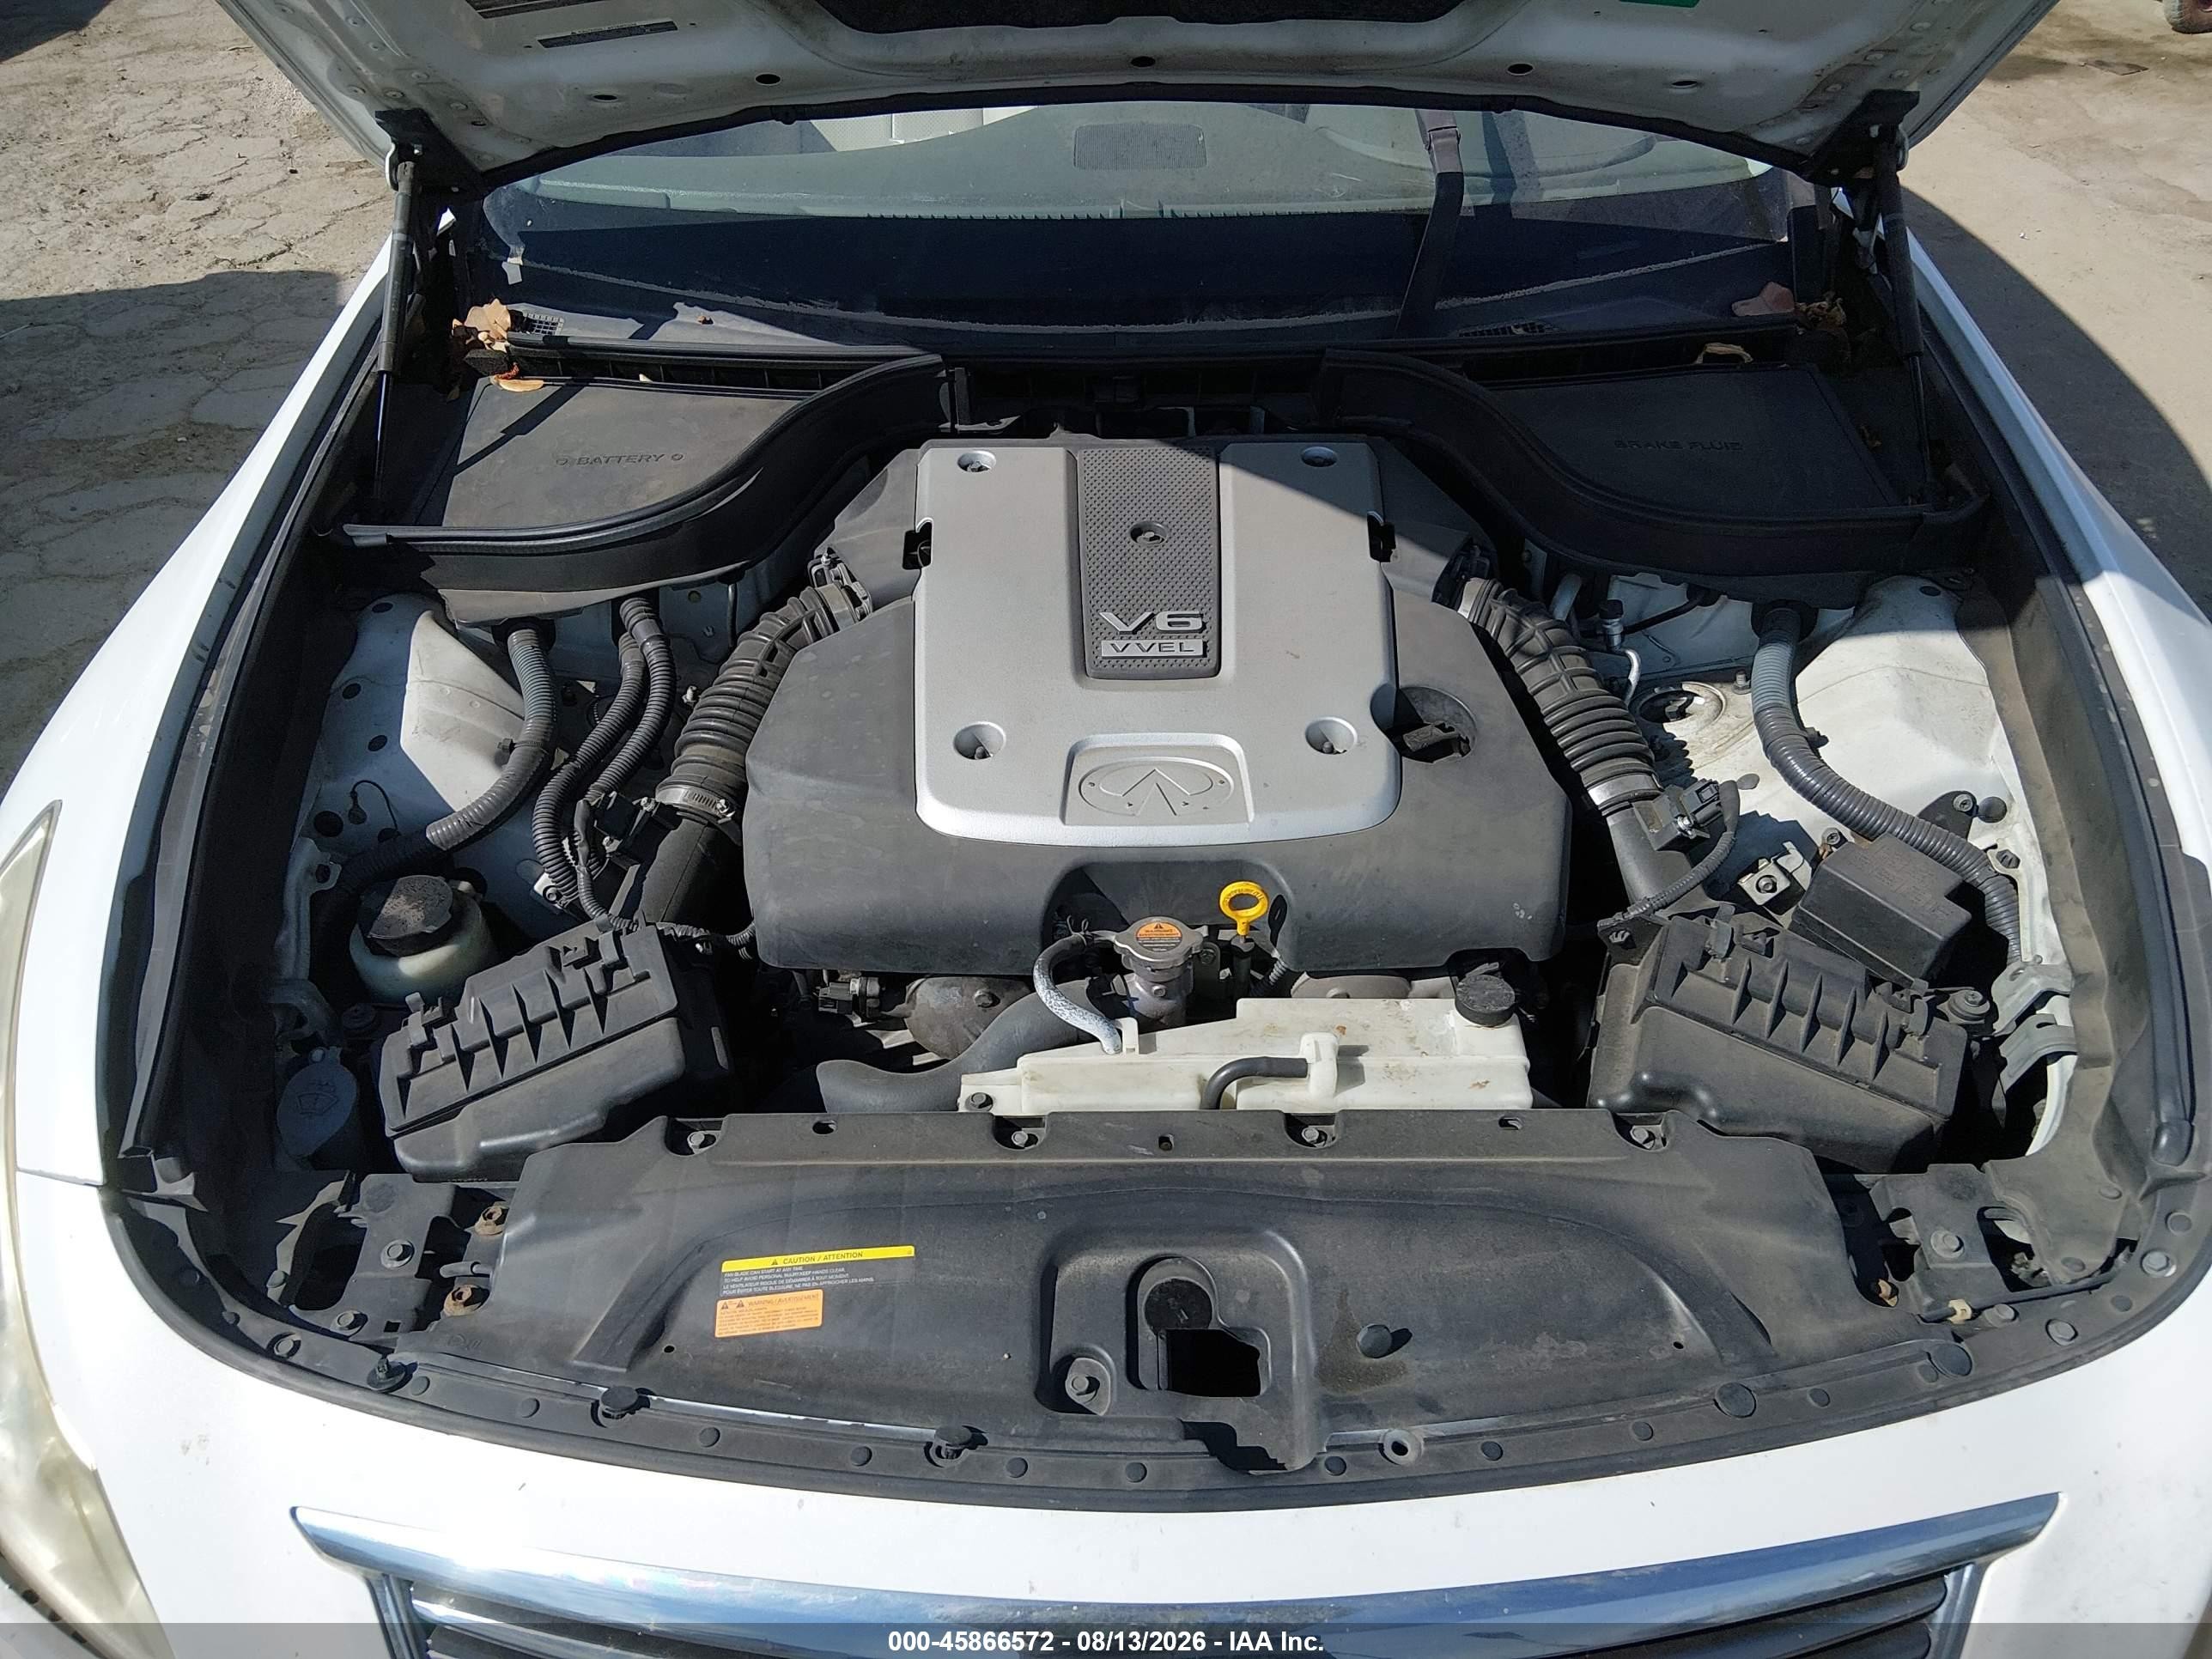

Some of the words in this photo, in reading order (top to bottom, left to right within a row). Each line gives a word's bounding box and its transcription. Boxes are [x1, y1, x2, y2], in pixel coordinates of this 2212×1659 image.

[1614, 440, 1683, 449] BRAKE
[576, 453, 665, 465] BATTERY
[1099, 611, 1204, 634] V6
[1110, 641, 1194, 653] VVEL
[783, 1256, 815, 1265] CAUTION
[823, 1251, 863, 1261] ATTENTION
